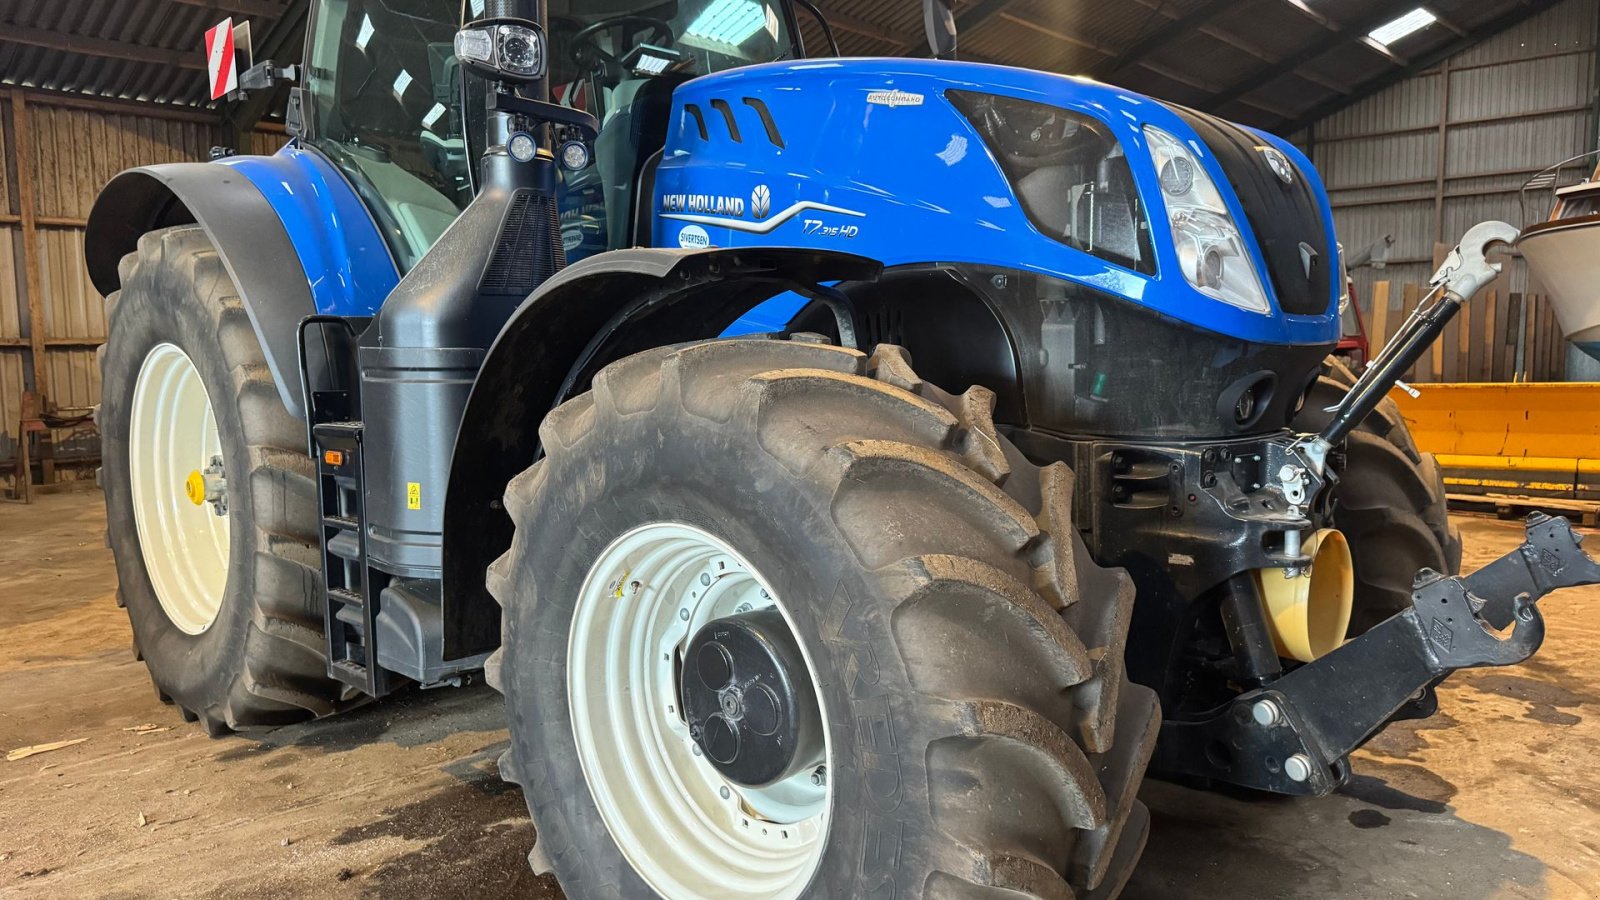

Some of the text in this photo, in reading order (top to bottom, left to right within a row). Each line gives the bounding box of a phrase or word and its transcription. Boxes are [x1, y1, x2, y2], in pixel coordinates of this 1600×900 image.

[663, 194, 744, 217] NEW HOLLAND
[839, 225, 858, 238] HD
[680, 232, 708, 246] SIVERTSEN
